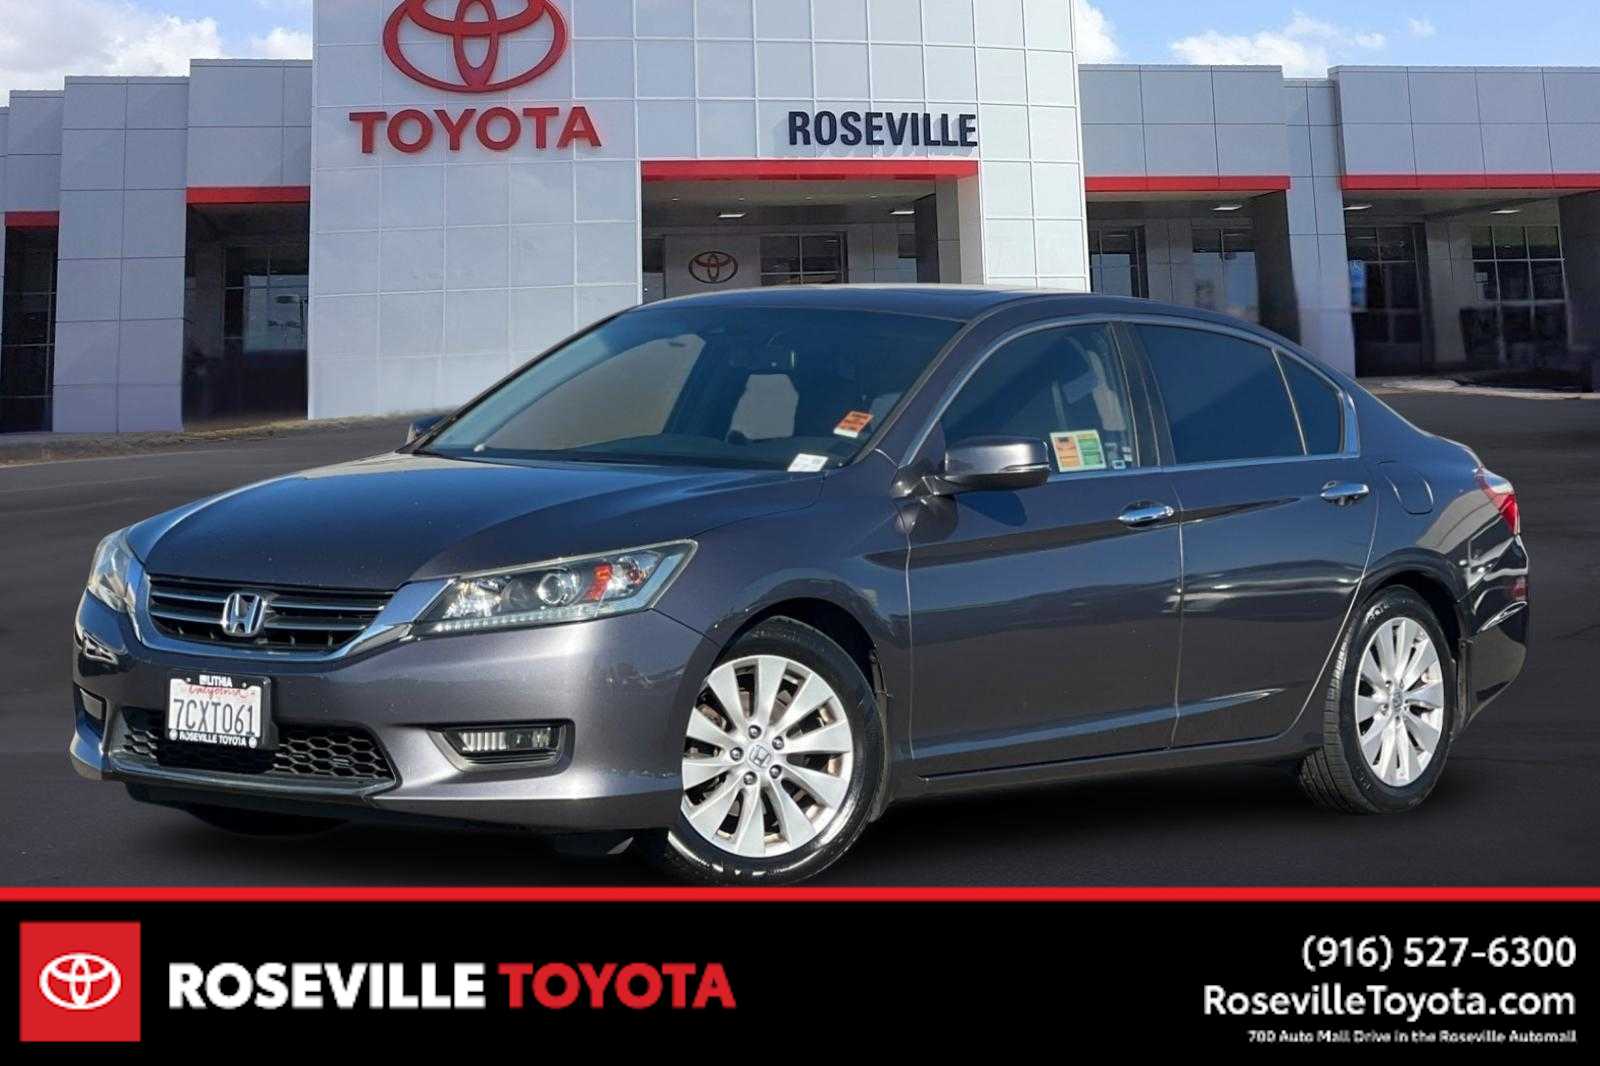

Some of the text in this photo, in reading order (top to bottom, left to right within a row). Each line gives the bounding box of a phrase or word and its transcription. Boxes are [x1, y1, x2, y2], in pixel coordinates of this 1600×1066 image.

[350, 106, 602, 154] TOYOTA
[789, 111, 978, 147] ROSEVILLE
[173, 698, 254, 735] 7CXT061
[179, 732, 247, 746] ROSEVILLE TOYOTA
